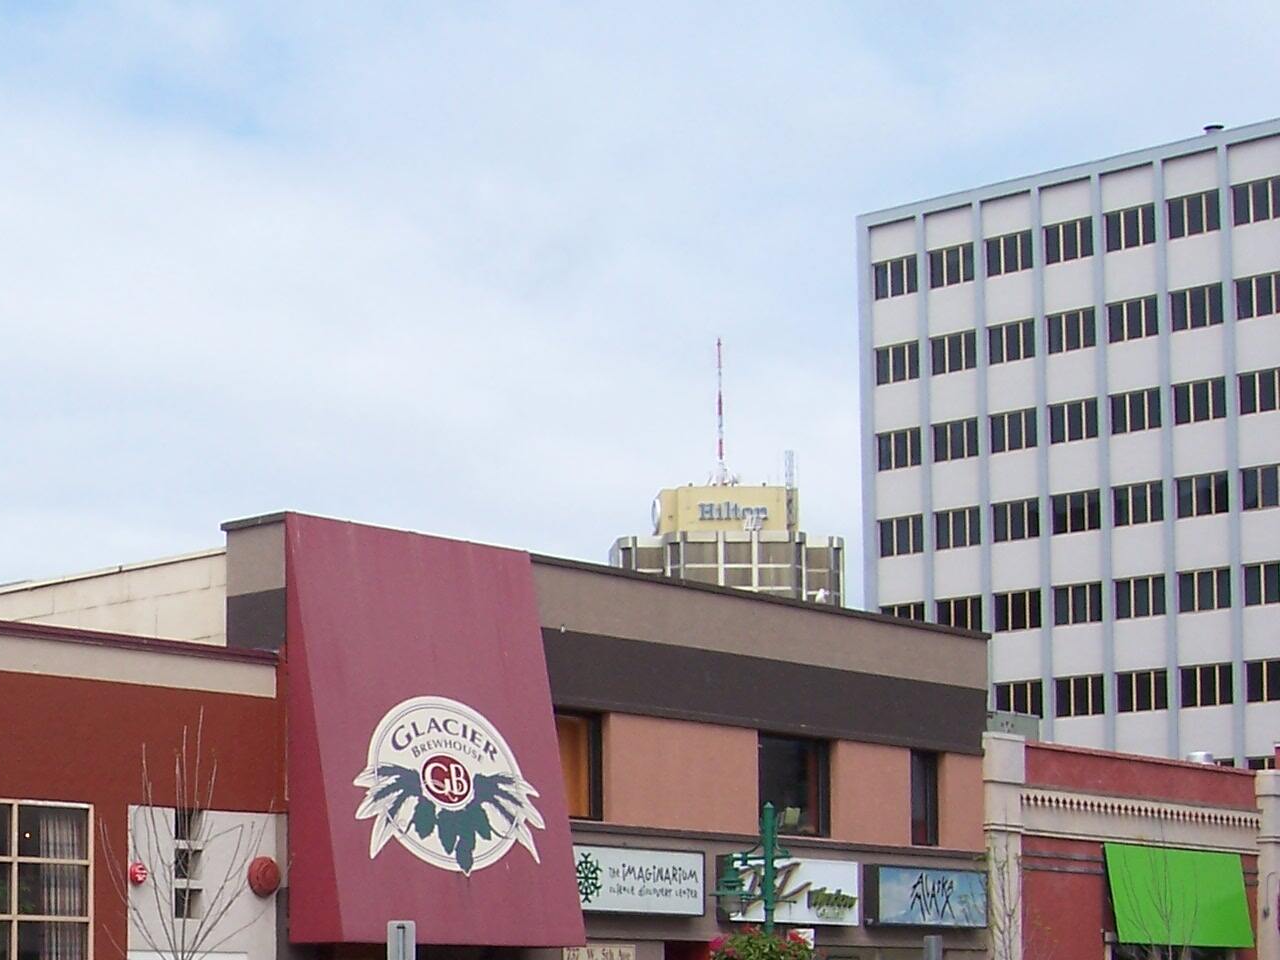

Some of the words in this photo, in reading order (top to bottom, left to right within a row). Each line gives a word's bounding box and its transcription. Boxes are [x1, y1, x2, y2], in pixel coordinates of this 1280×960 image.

[699, 501, 768, 520] Hilton
[392, 717, 498, 762] GLACIER
[411, 739, 482, 762] BREWHOUSE
[424, 762, 469, 802] GB
